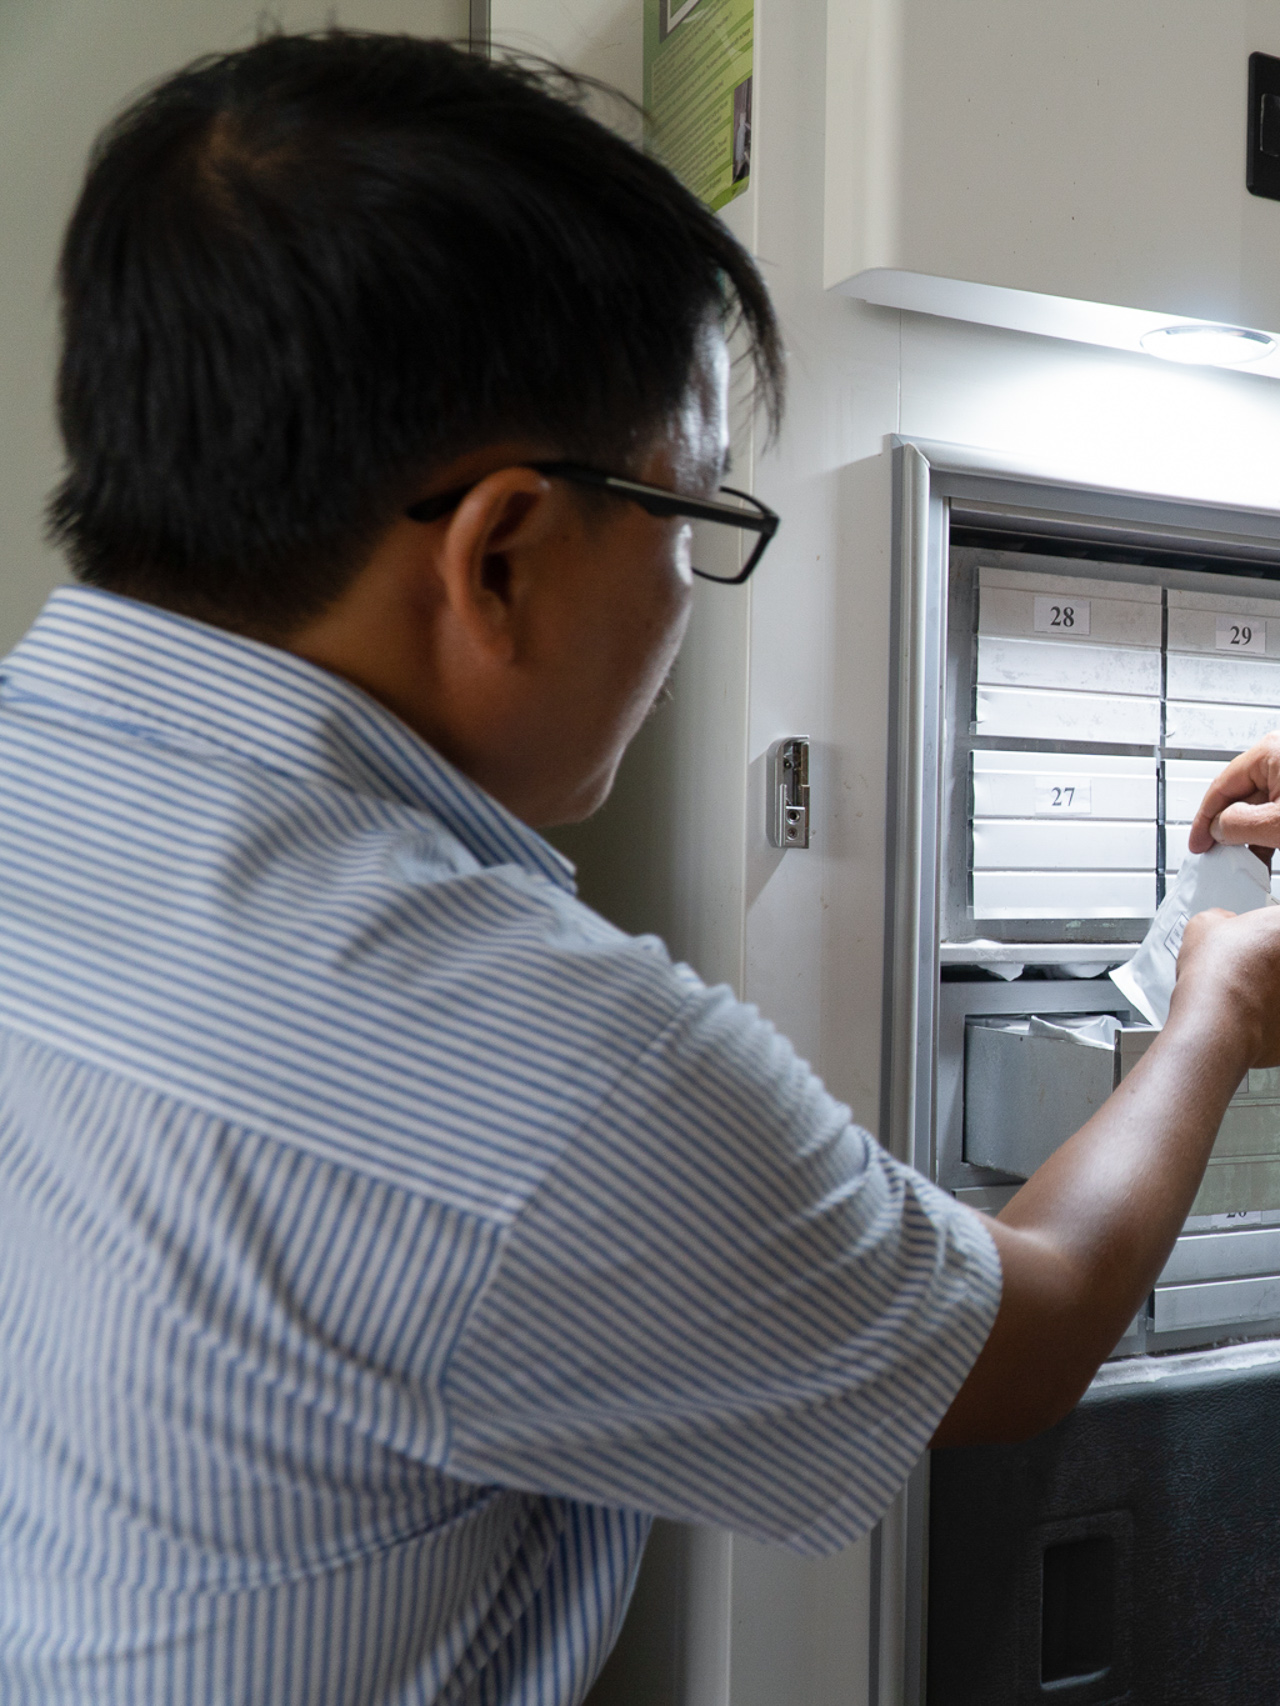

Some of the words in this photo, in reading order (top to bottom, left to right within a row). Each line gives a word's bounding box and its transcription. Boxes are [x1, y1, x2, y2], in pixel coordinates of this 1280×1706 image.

[1050, 606, 1075, 627] 28
[1230, 625, 1252, 646] 29
[1051, 786, 1076, 807] 27
